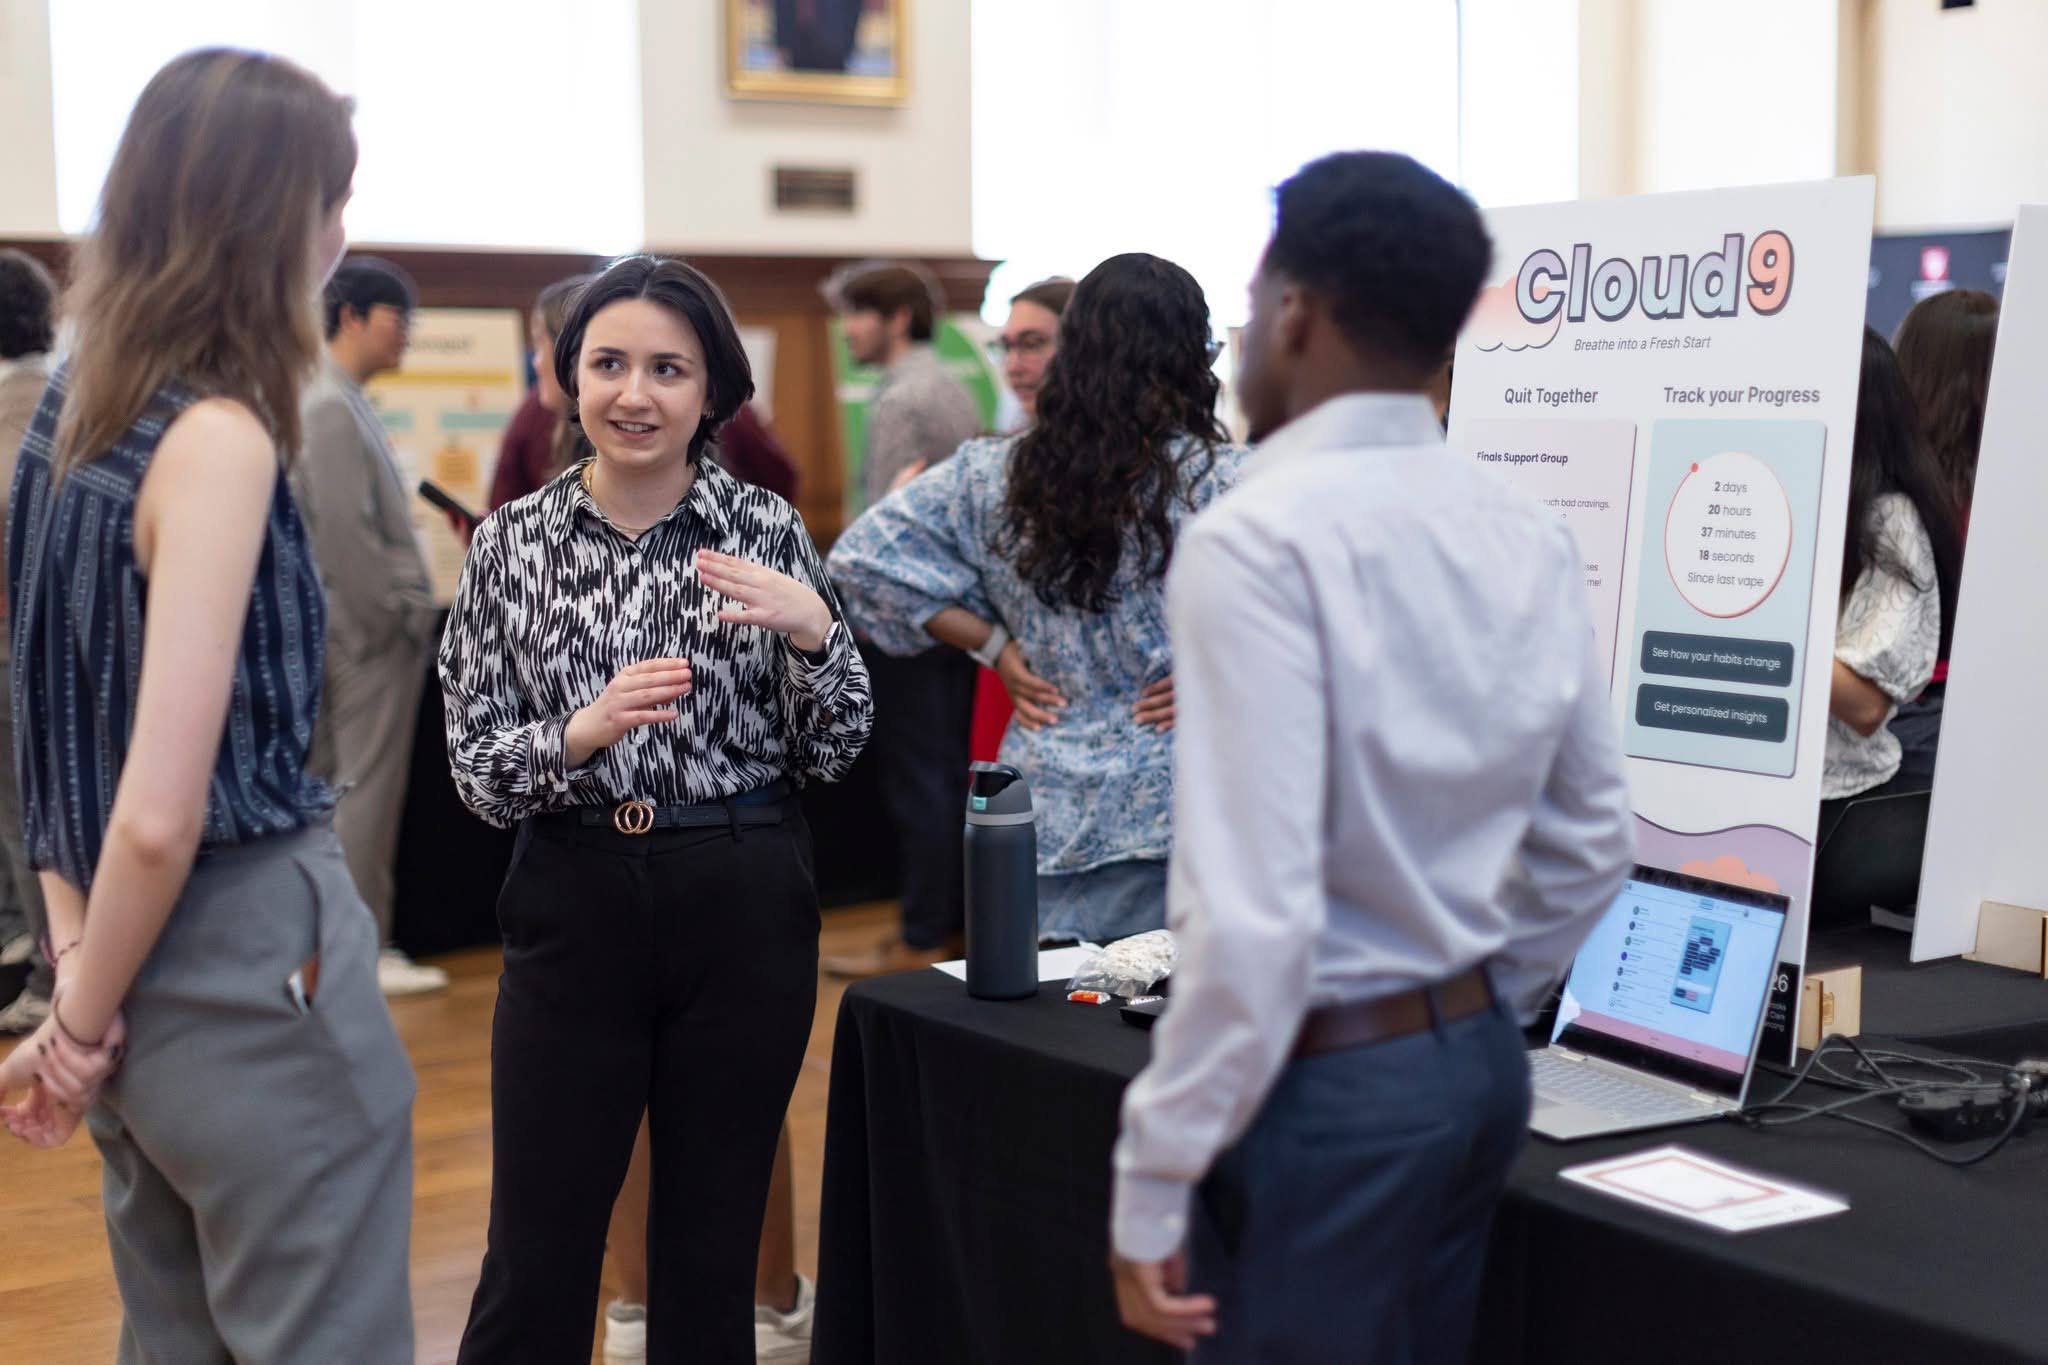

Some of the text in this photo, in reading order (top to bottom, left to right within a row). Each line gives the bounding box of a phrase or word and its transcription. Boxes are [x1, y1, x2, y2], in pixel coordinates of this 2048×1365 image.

[1515, 230, 1795, 324] Cloud9
[1574, 335, 1711, 352] Breathe into a Fresh Start
[1504, 388, 1598, 408] Quit Together
[1664, 387, 1820, 407] Track your Progress
[1477, 451, 1568, 466] Finals Support Group
[1714, 481, 1748, 495] 2 days
[1561, 498, 1576, 508] bad
[1708, 504, 1752, 517] 20 hours
[1701, 527, 1757, 540] 37 minutes
[1699, 550, 1755, 564] 18 seconds
[1687, 572, 1764, 589] Since last vape
[1652, 647, 1782, 670] See how your habits change
[1654, 701, 1768, 724] Get personalized insights
